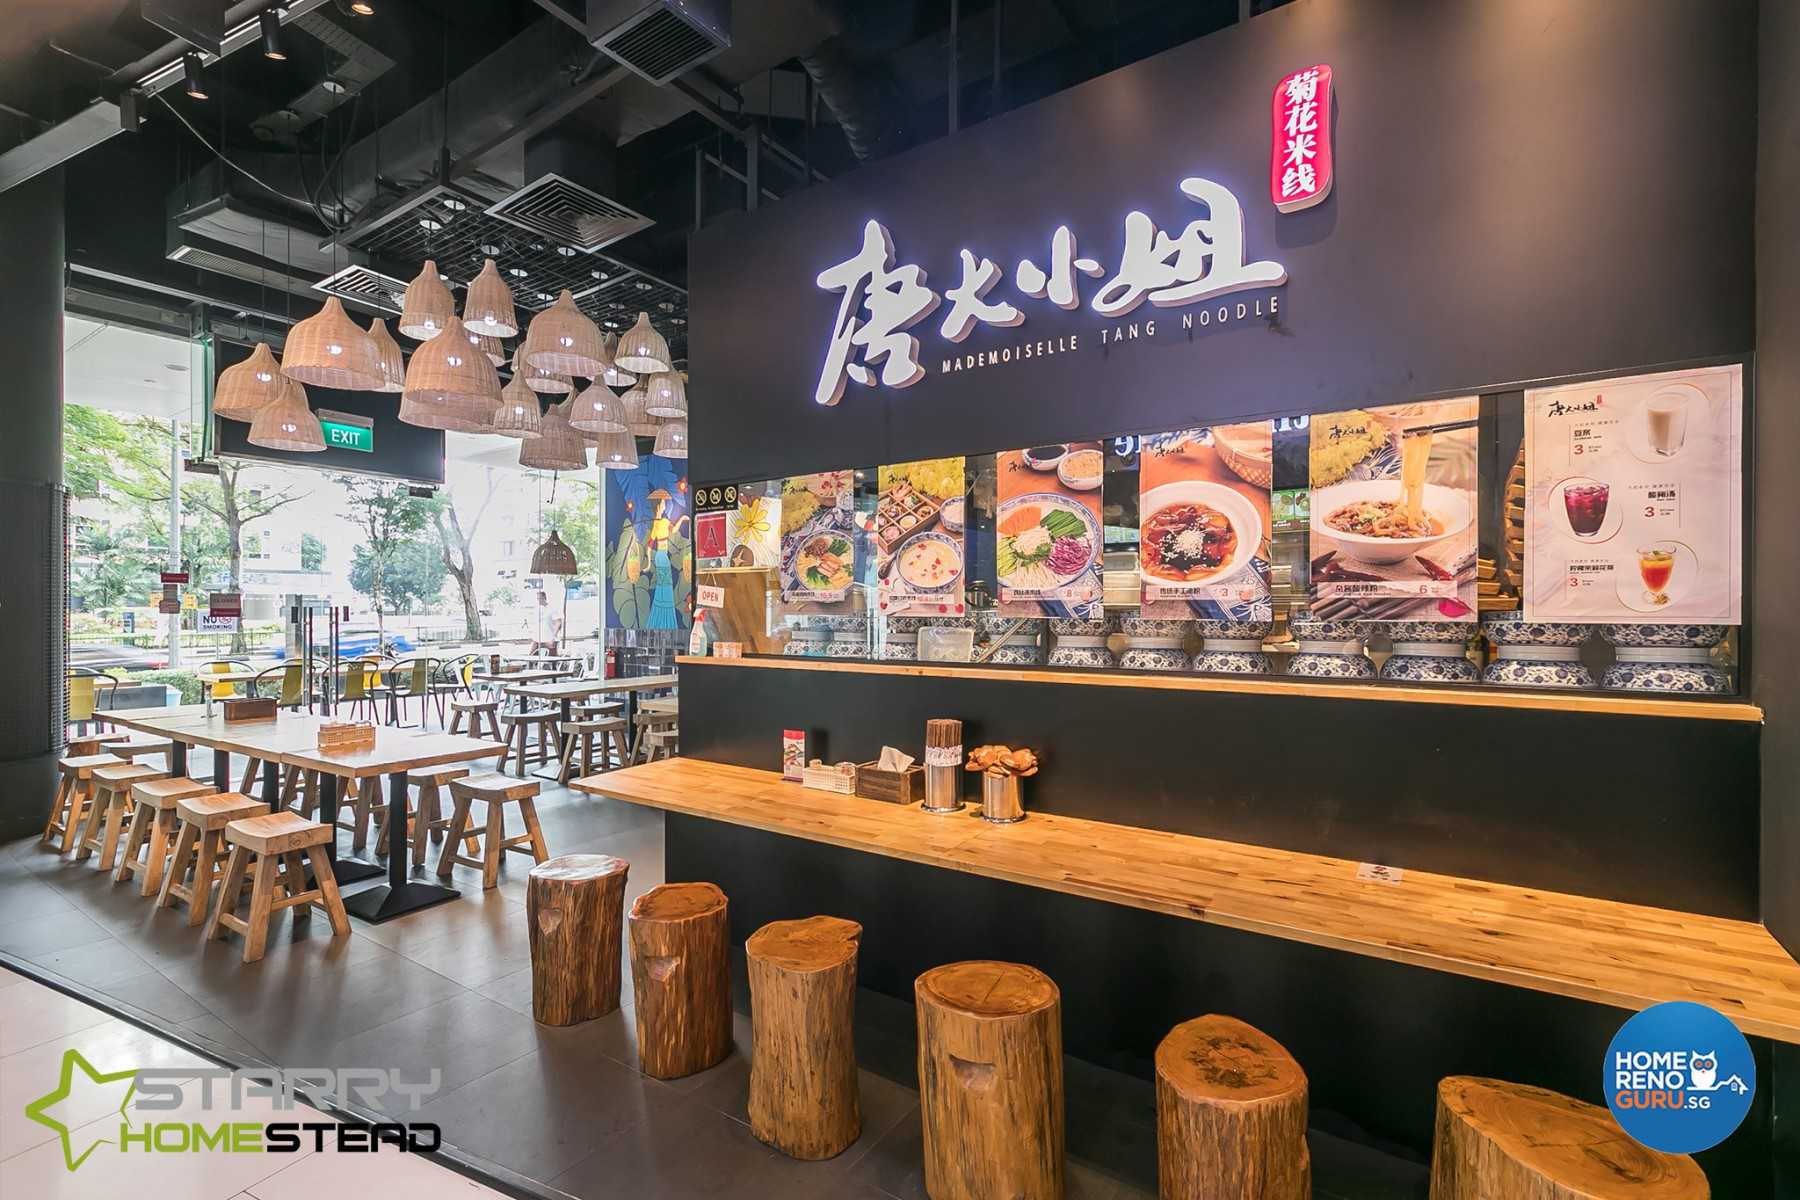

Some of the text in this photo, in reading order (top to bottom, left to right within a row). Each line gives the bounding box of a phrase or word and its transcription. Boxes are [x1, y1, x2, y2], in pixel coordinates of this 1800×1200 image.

[1282, 70, 1318, 197] 菊花米线
[815, 177, 1287, 406] 唐大小姐
[942, 296, 1278, 373] MADEMOISELLE TANG NOODLE
[331, 428, 360, 445] EXIT
[1574, 444, 1584, 455] 3
[1644, 506, 1655, 517] 3
[1570, 577, 1578, 587] 3
[1420, 584, 1428, 594] 6
[702, 591, 719, 599] OPEN
